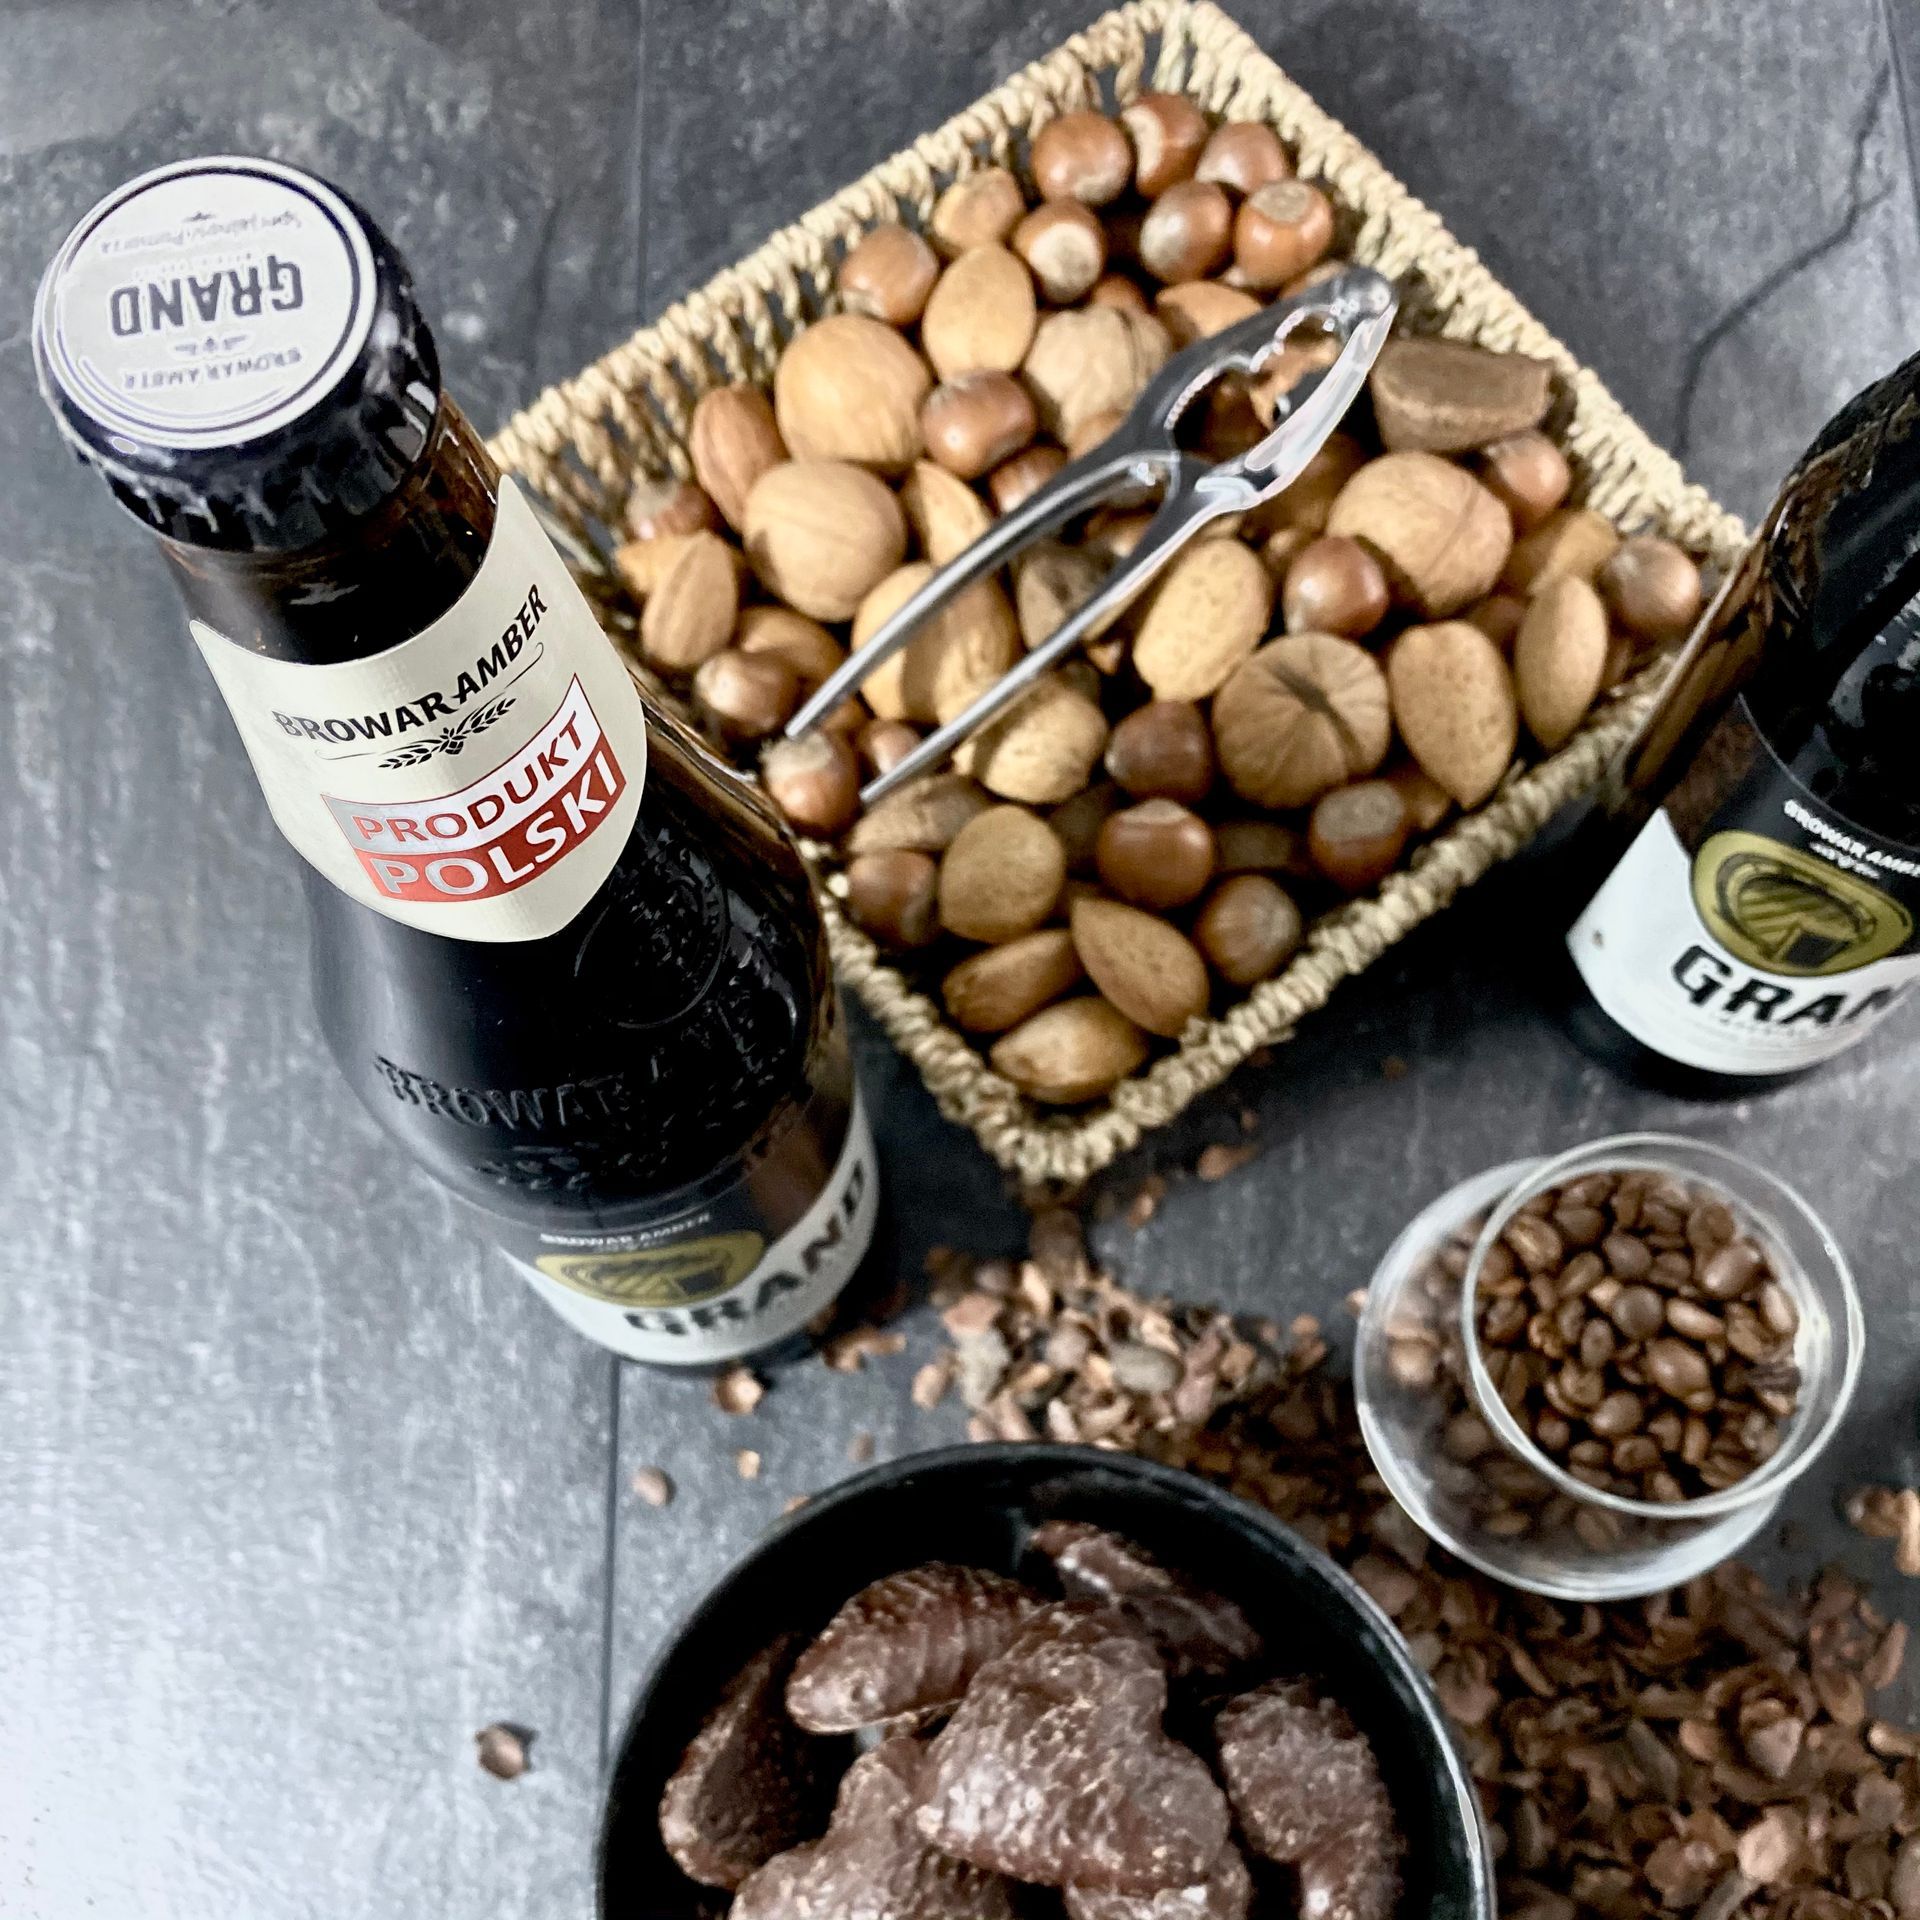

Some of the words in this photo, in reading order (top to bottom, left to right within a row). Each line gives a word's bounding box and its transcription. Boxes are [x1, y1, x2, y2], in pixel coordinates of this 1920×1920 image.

[110, 254, 303, 336] GRAND
[271, 691, 459, 745] BROWAR
[451, 583, 548, 705] AMBER
[351, 710, 582, 843] PRODUKT
[369, 750, 618, 896] POLSKI
